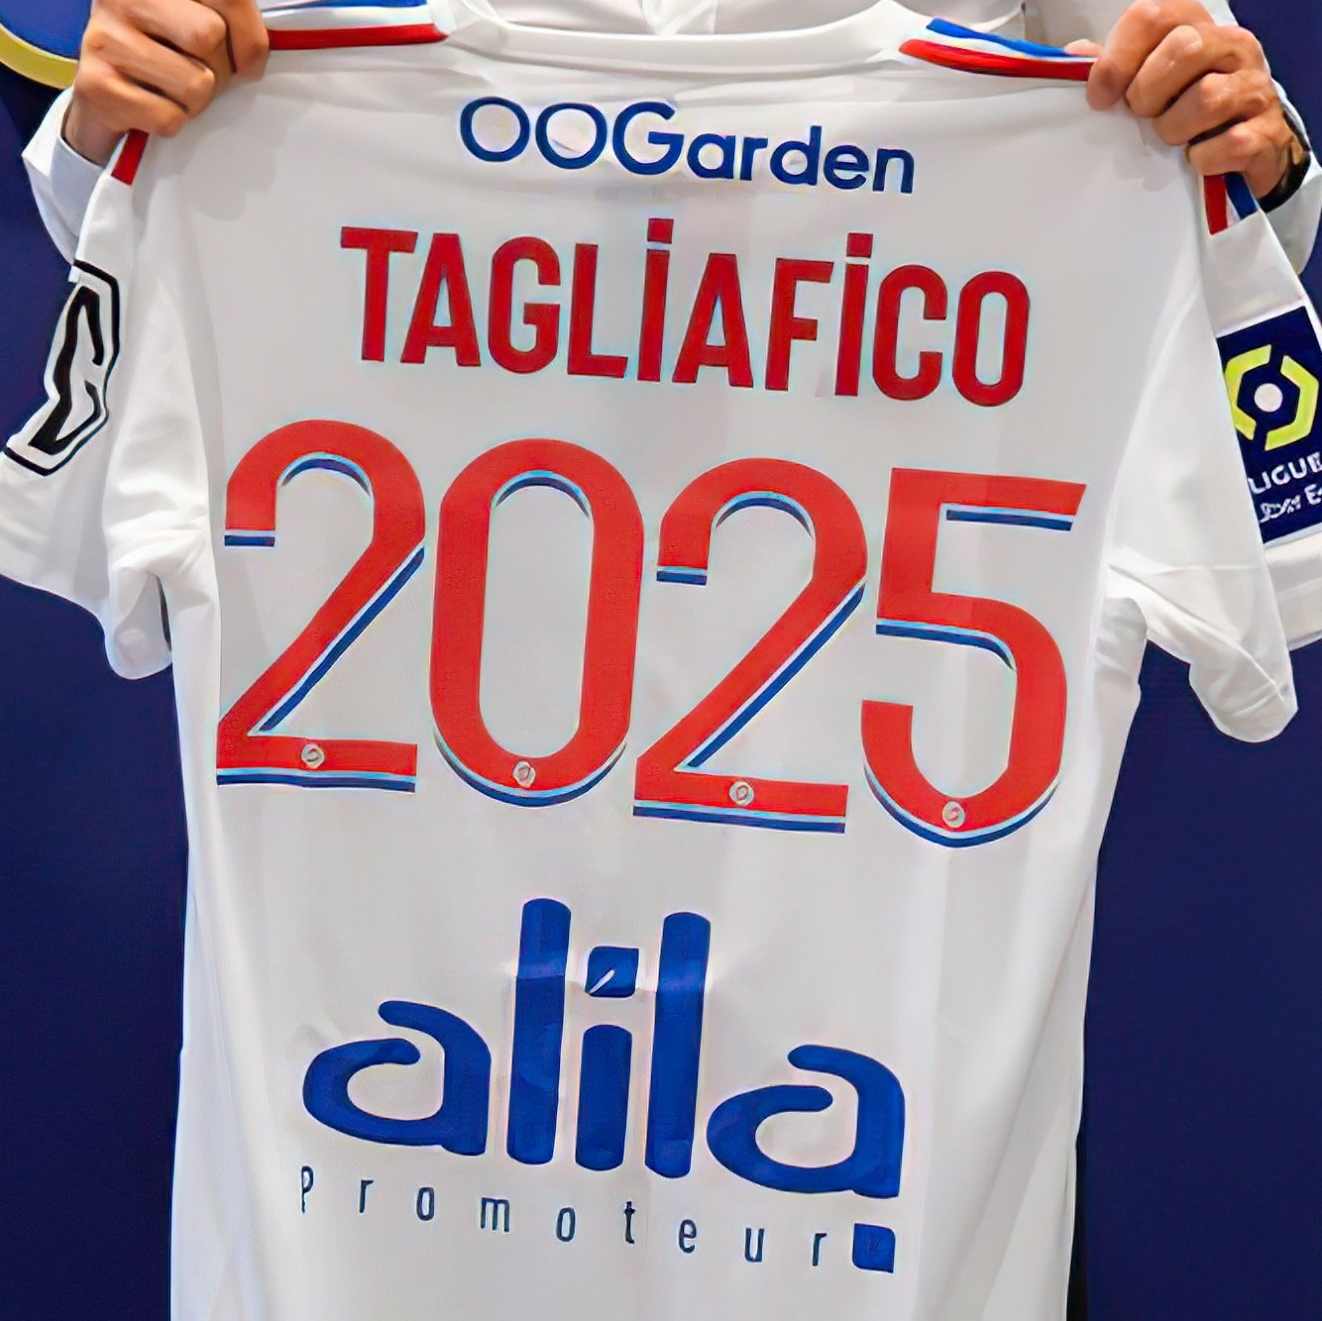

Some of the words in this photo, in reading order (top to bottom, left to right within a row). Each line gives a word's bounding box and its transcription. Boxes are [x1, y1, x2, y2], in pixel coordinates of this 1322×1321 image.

[459, 96, 915, 194] OOGarden
[215, 418, 1087, 849] 2025
[302, 897, 906, 1200] alila
